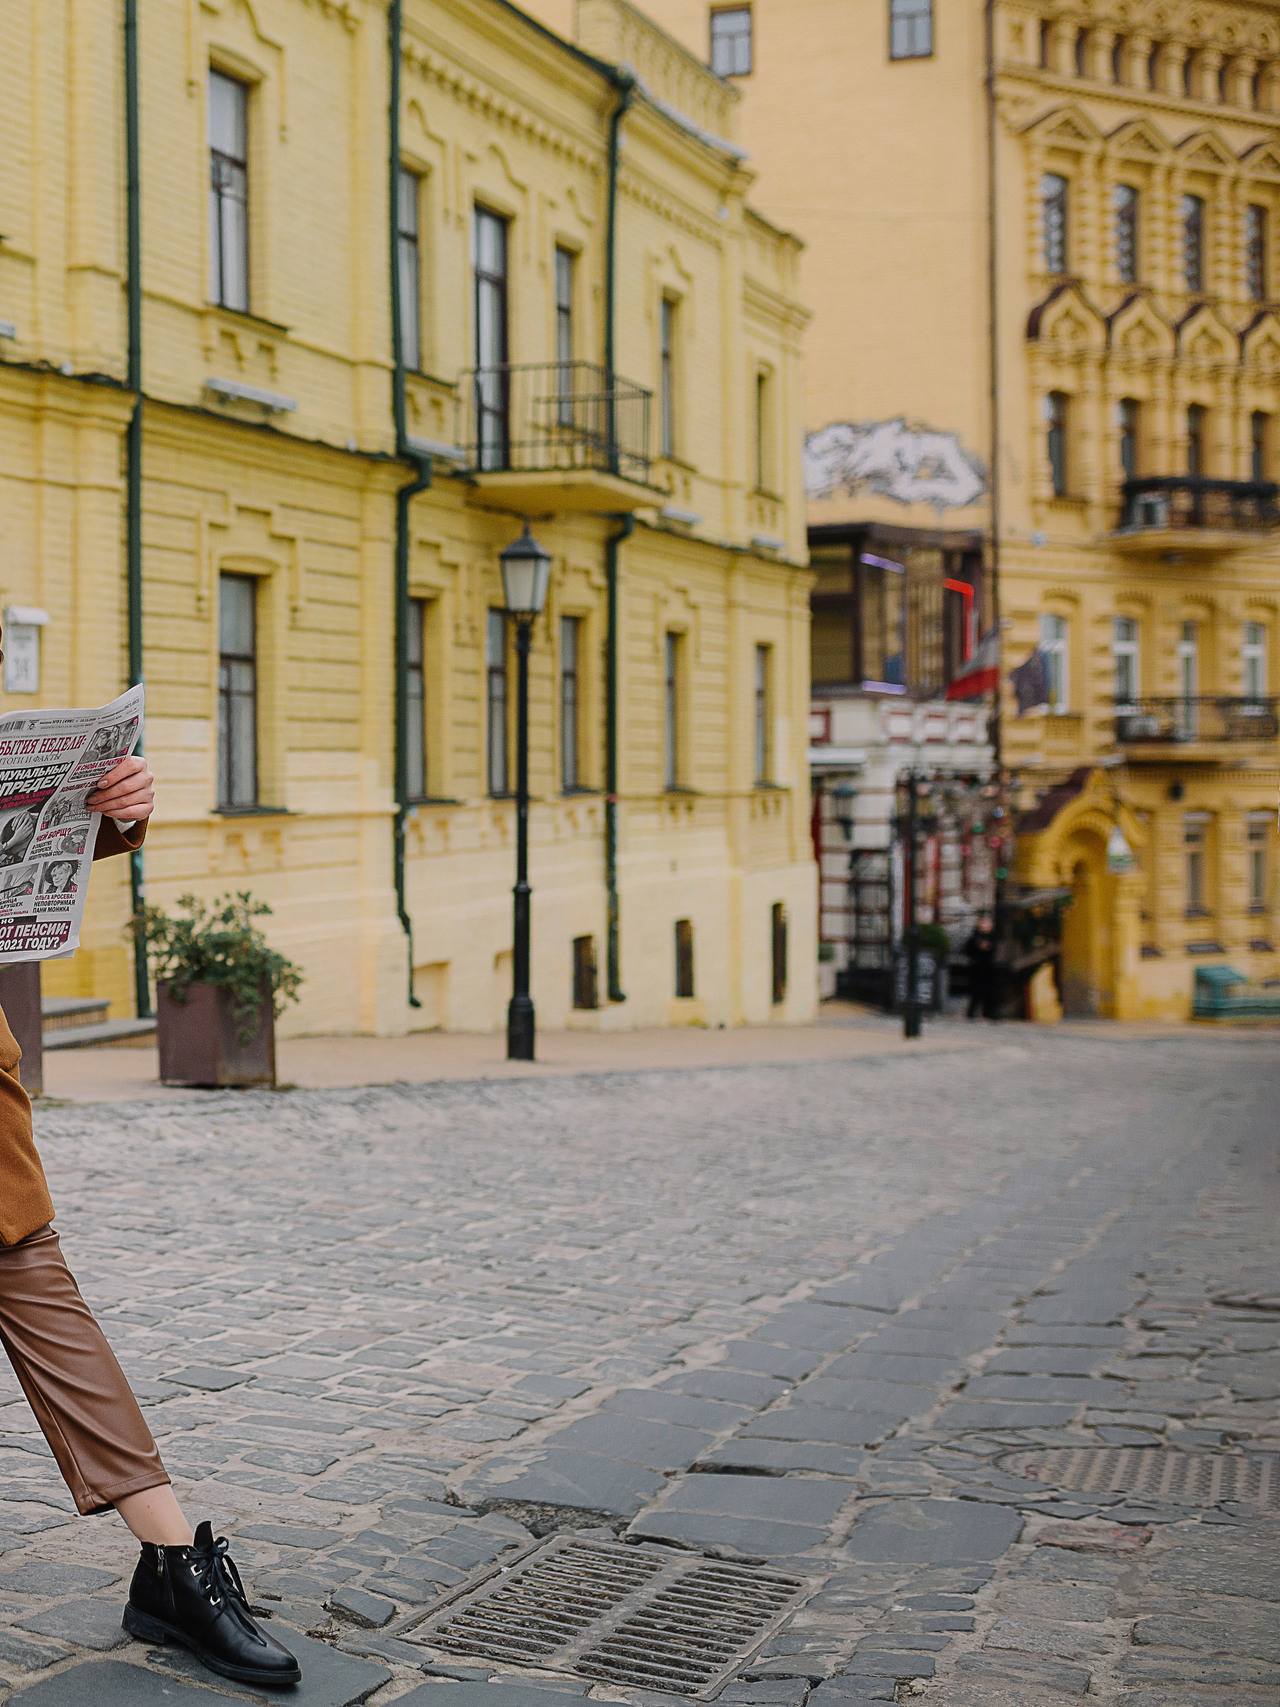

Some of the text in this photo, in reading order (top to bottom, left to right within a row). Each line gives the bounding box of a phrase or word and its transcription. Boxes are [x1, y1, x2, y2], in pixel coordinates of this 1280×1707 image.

[40, 735, 87, 755] НЕДЕЛИ:
[33, 753, 62, 764] ФАКТЫ
[34, 899, 76, 907] НЕПОВТОРИМАЯ
[13, 922, 69, 938] ПЕНСИИ:
[24, 936, 60, 950] ГОДУ?
